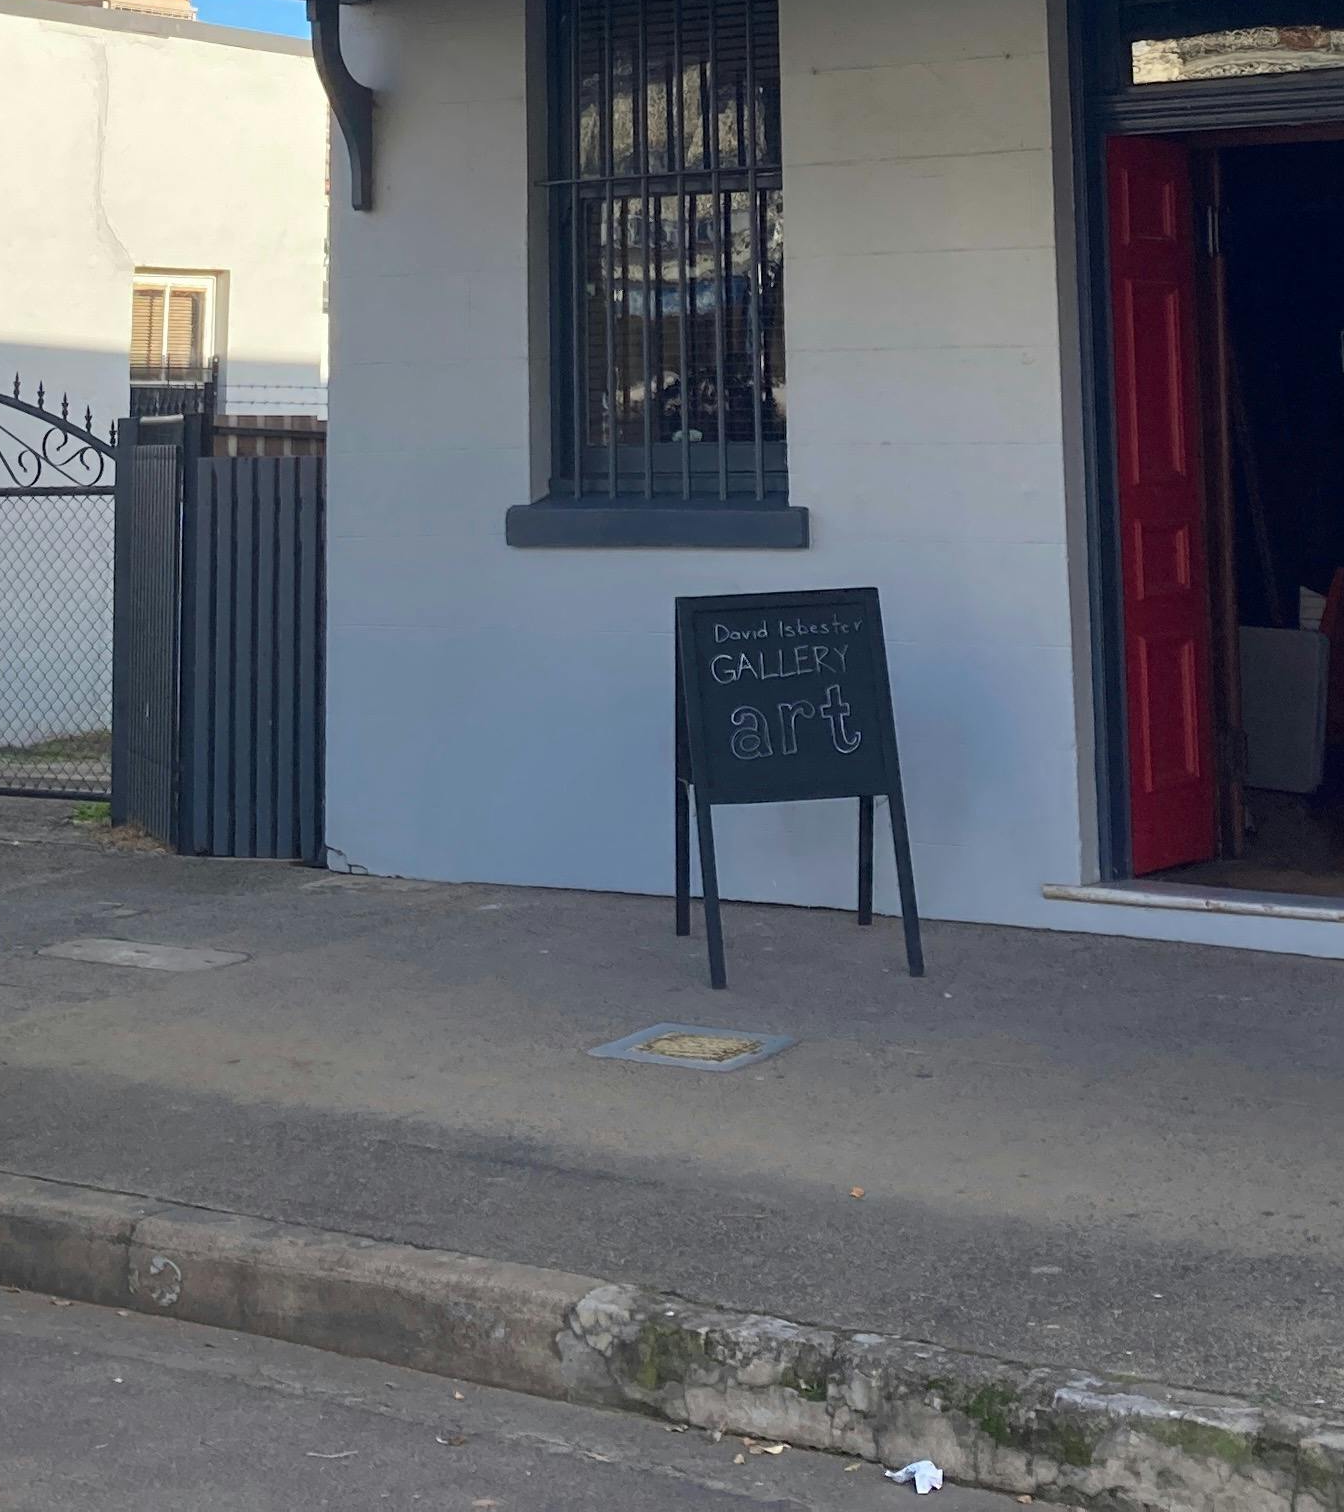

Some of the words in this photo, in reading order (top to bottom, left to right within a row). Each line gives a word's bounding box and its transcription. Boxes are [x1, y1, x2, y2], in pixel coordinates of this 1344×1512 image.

[713, 620, 768, 643] David
[711, 645, 848, 684] GALLERY
[731, 684, 861, 760] art
